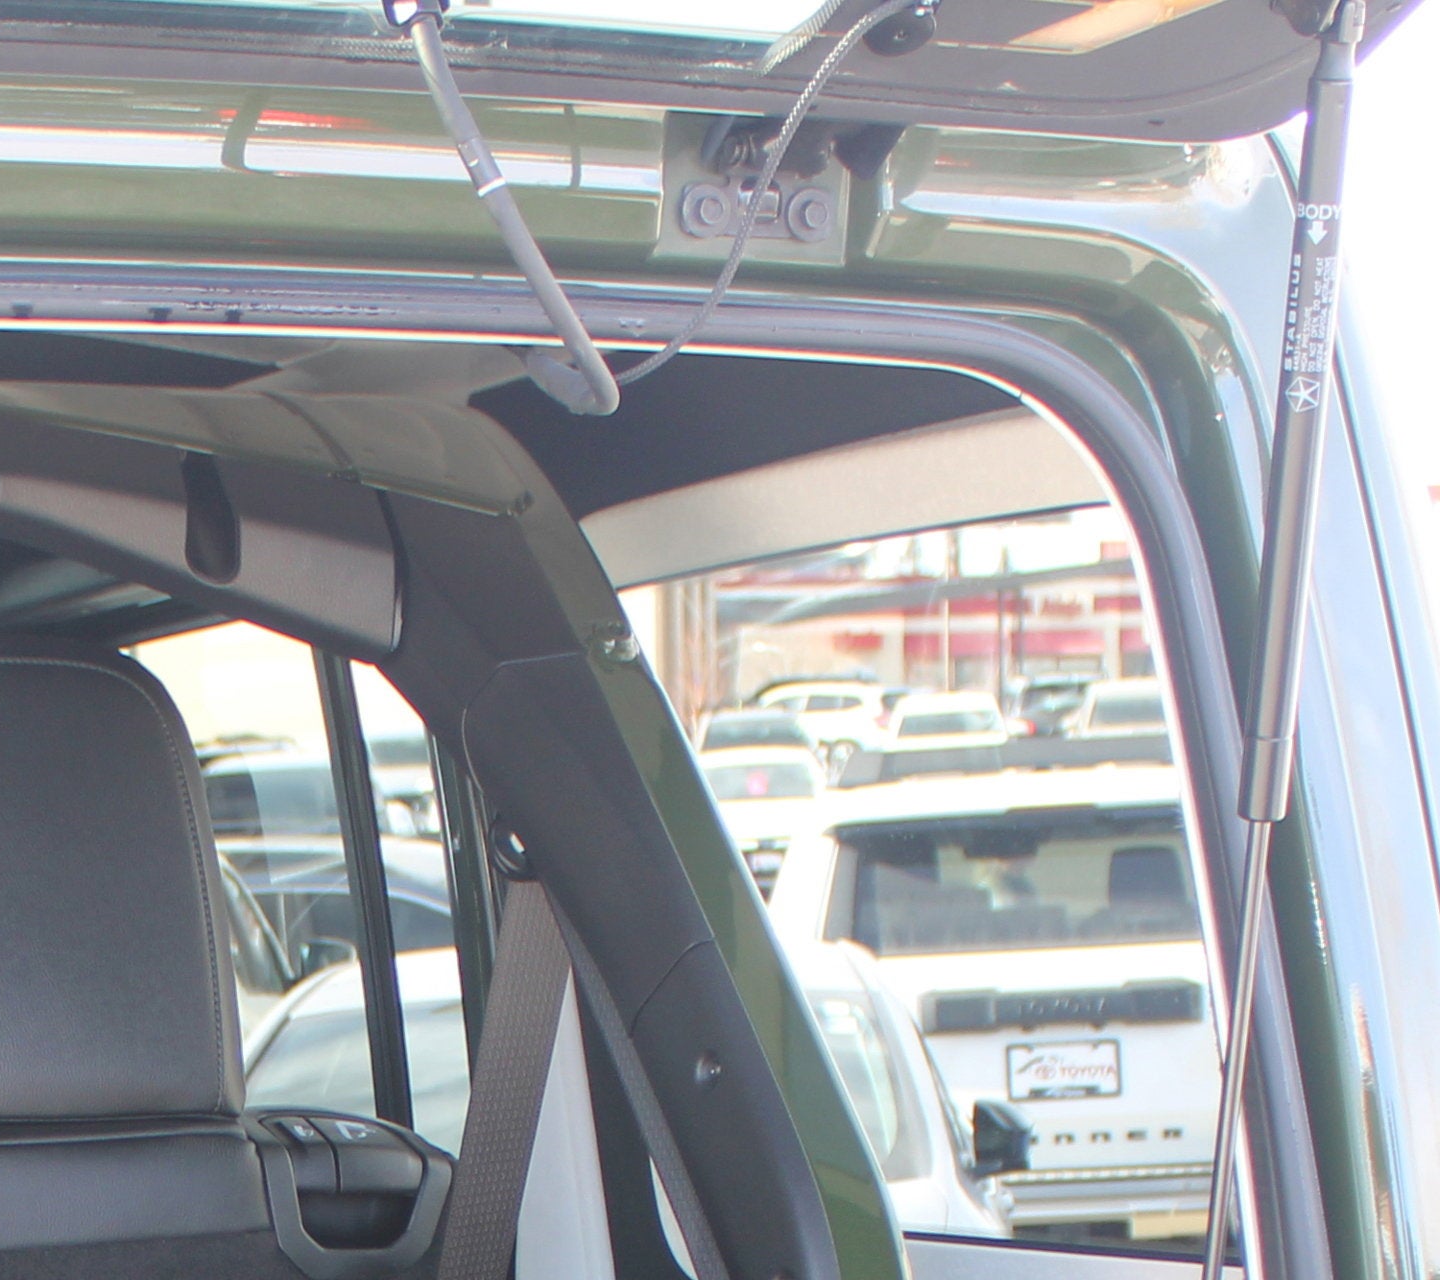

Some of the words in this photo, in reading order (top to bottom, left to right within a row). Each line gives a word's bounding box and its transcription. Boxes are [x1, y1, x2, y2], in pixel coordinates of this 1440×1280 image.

[1297, 203, 1341, 220] BODY
[1284, 254, 1302, 371] STABILUS
[1313, 299, 1320, 311] DO
[1059, 1062, 1117, 1080] TOYOTA
